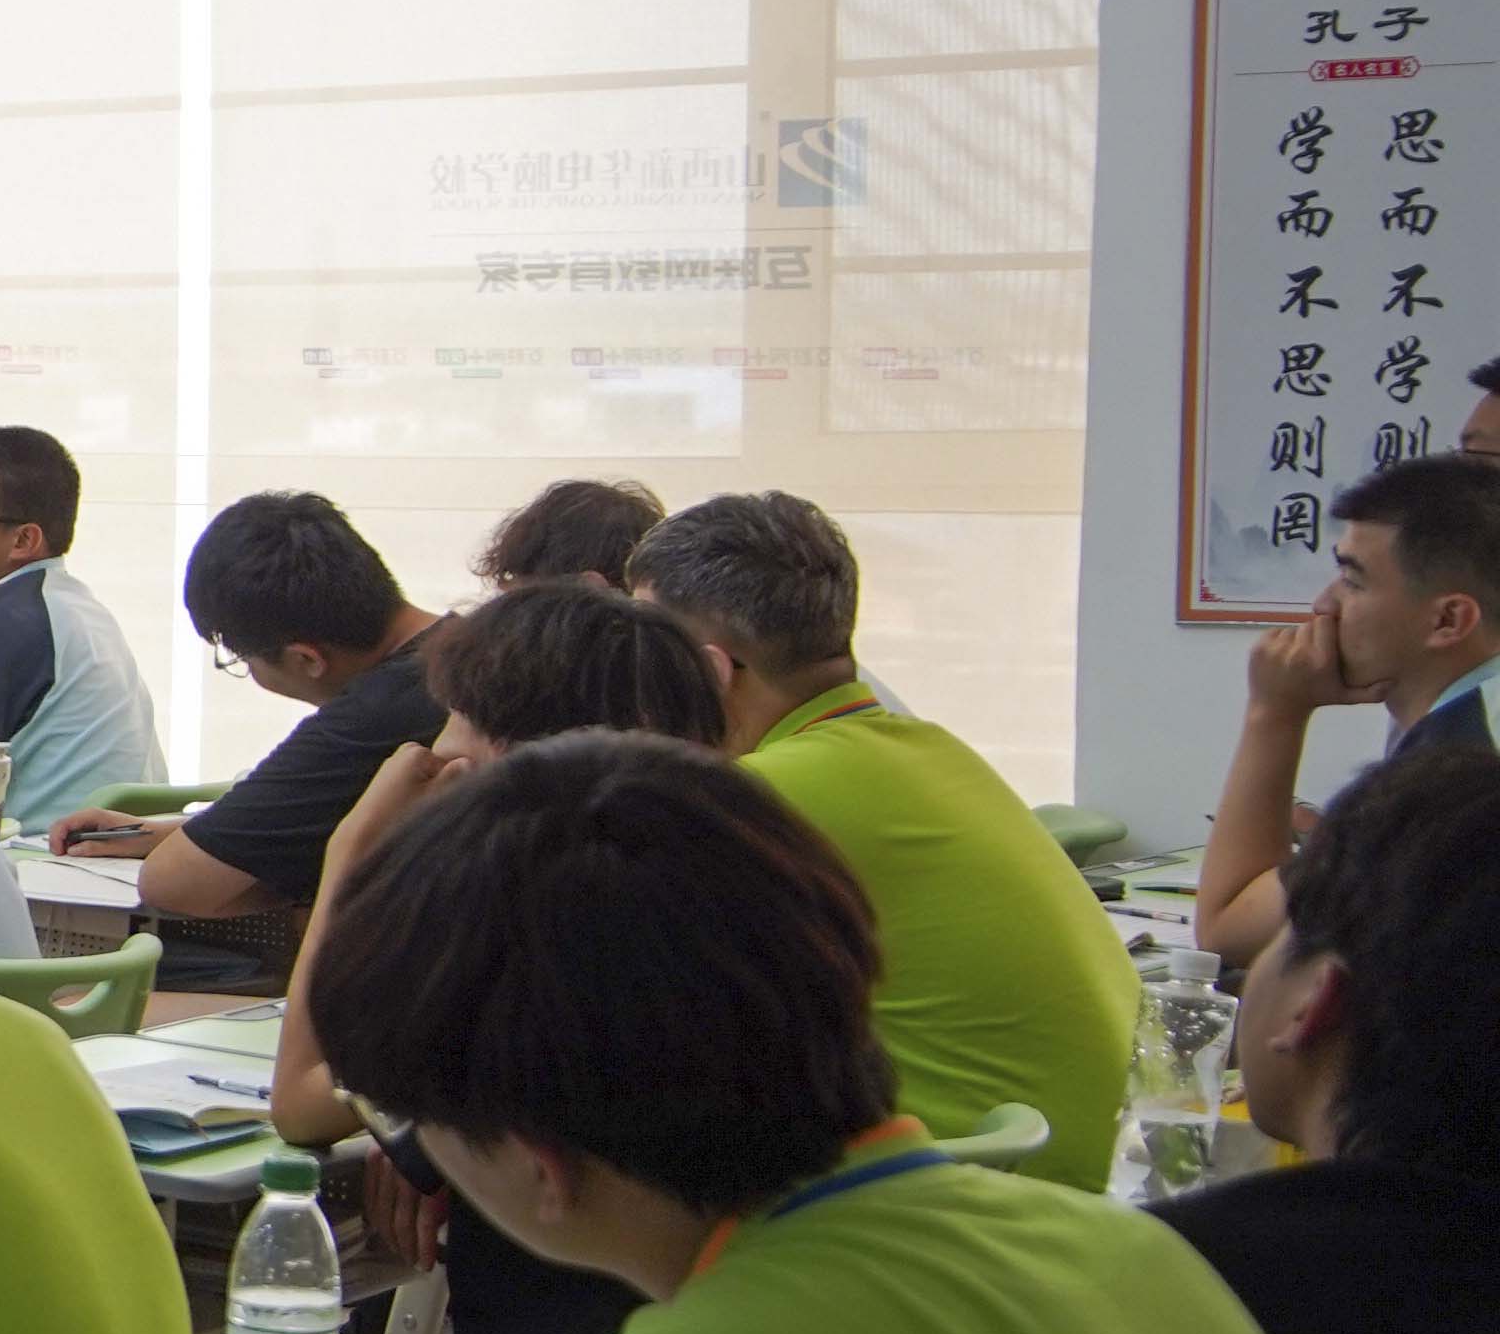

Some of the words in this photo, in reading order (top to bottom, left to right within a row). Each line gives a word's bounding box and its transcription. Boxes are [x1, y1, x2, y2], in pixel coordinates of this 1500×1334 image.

[1303, 6, 1430, 44] 孔子
[1269, 105, 1339, 554] 学而不思则罔
